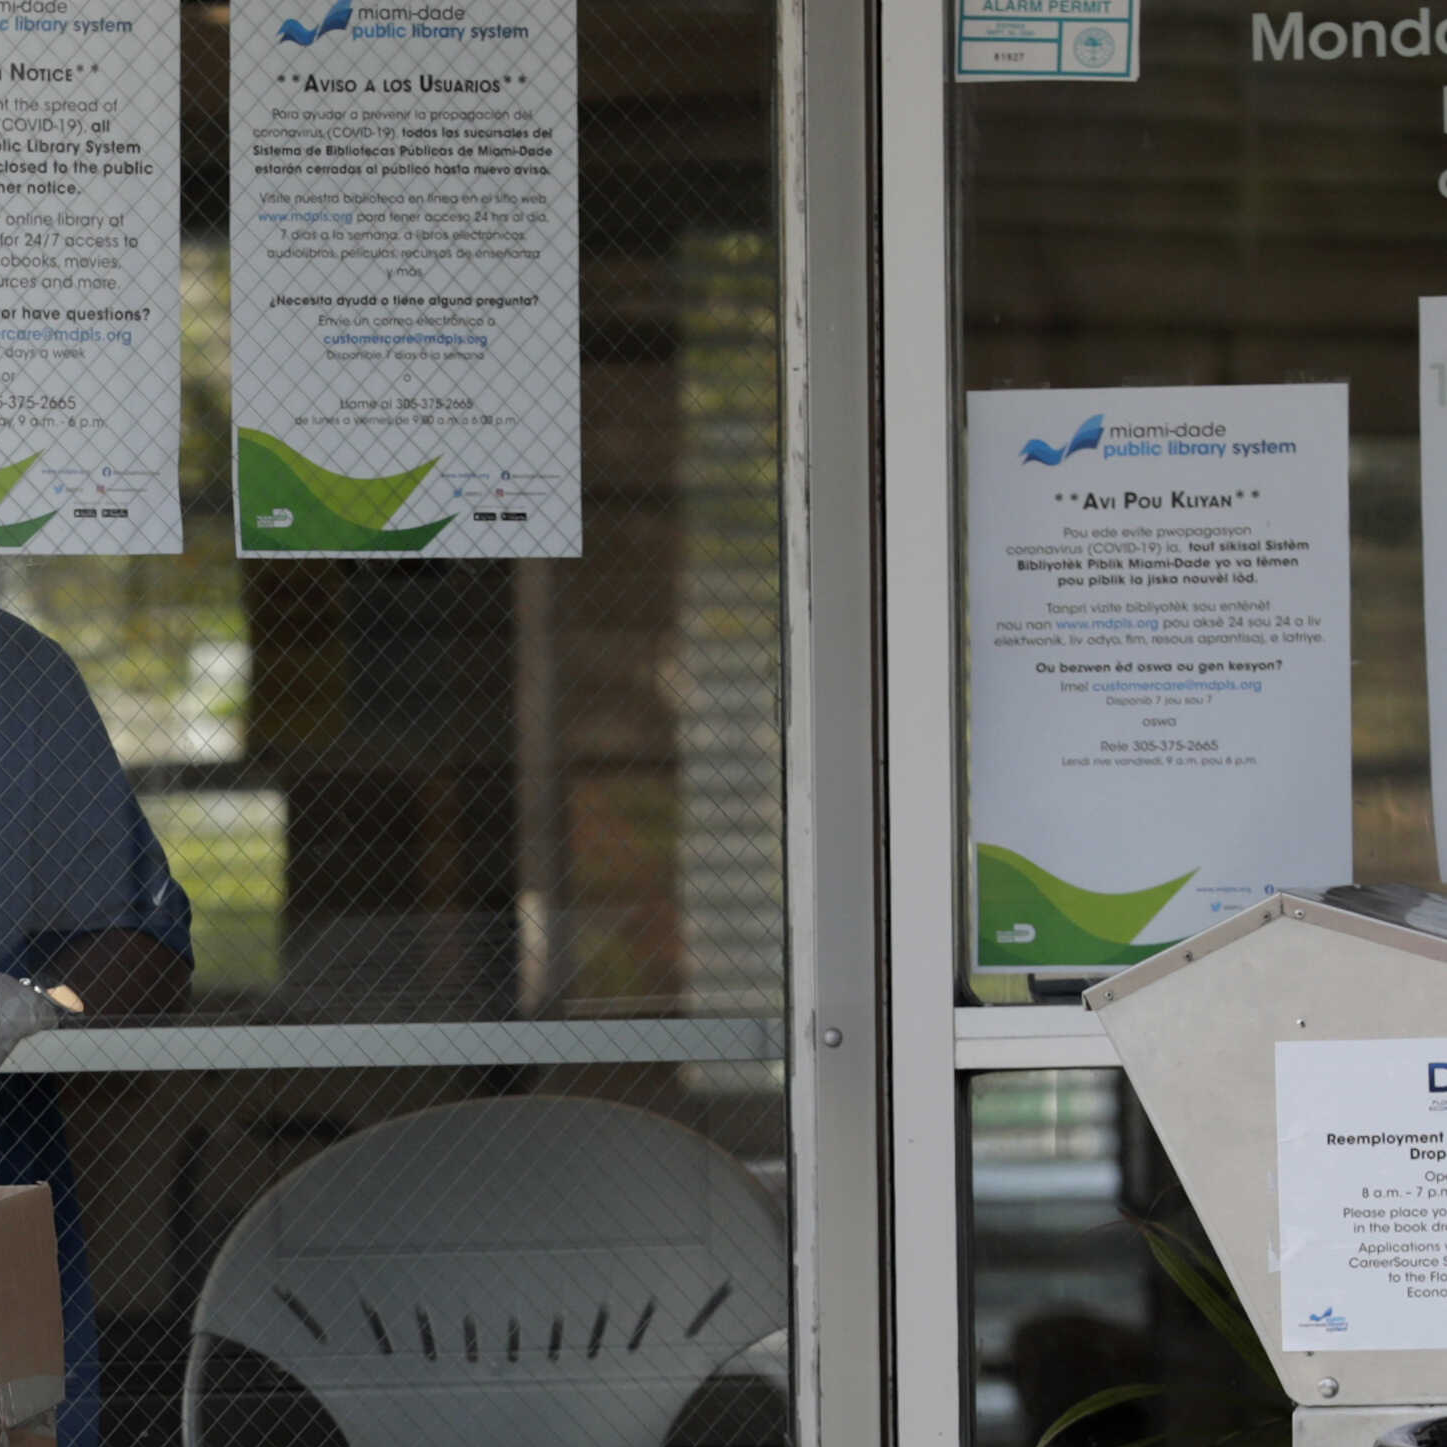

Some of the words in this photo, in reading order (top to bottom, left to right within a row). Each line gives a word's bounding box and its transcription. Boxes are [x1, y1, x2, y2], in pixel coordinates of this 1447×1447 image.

[359, 4, 465, 21] miami-dade
[983, 0, 1042, 12] ALARM
[1049, 0, 1110, 13] PERMIT
[15, 17, 68, 34] library
[73, 19, 133, 33] system
[352, 24, 406, 41] public
[412, 24, 465, 41] library
[470, 25, 529, 40] system
[26, 139, 79, 156] Library
[85, 141, 141, 156] System
[1, 308, 18, 320] or
[22, 307, 60, 321] have
[66, 308, 151, 324] questions?
[1109, 422, 1227, 438] miami-dade
[1103, 442, 1163, 459] public
[1167, 441, 1227, 458] library
[1232, 440, 1297, 457] system
[1327, 1131, 1444, 1146] Reemployment
[1362, 1188, 1369, 1198] 8
[1373, 1189, 1402, 1198] a.m.
[1416, 1187, 1423, 1197] 7
[1343, 1208, 1386, 1218] Please
[1390, 1208, 1428, 1220] place
[1354, 1222, 1365, 1233] in
[1370, 1222, 1390, 1233] the
[1394, 1222, 1427, 1233] book
[1358, 1242, 1441, 1254] Applications
[1349, 1257, 1439, 1268] CareerSource
[1388, 1272, 1401, 1283] to
[1405, 1272, 1426, 1283] the
